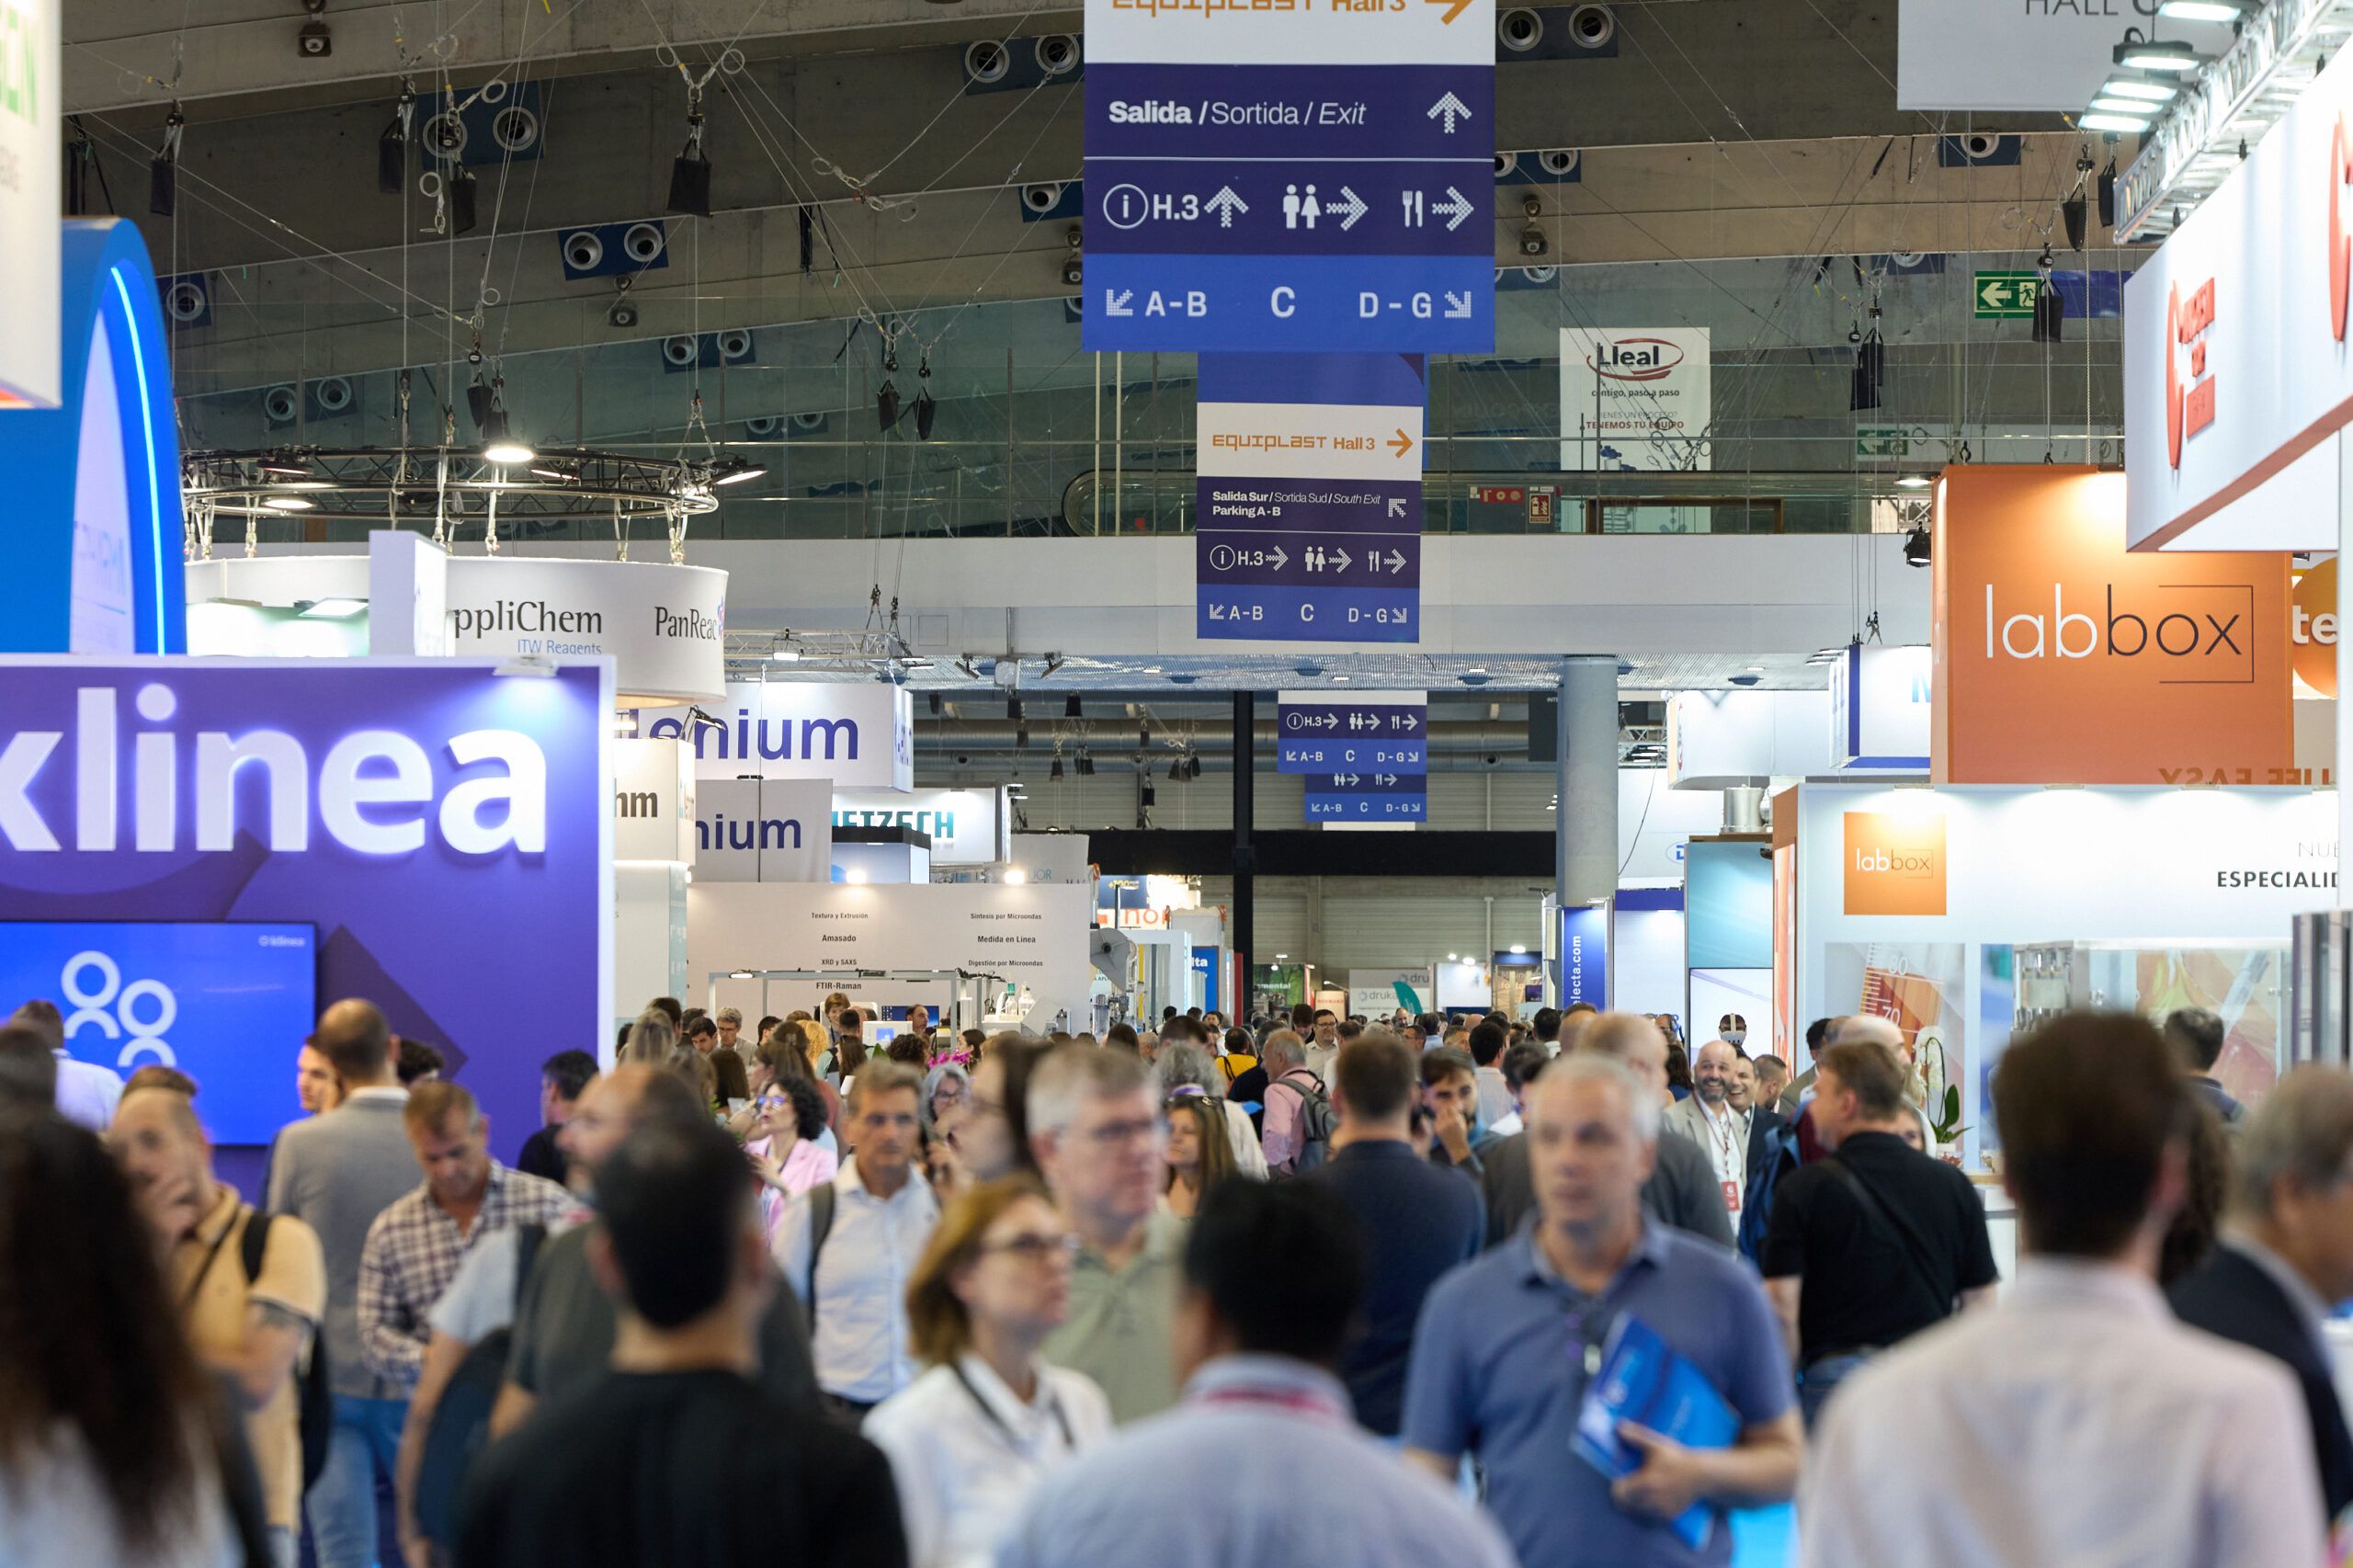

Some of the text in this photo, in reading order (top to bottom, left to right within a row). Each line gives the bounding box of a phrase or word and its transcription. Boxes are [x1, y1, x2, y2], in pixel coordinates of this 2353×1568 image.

[2025, 0, 2119, 16] HALL
[1108, 99, 1193, 124] Salida
[1211, 100, 1300, 125] Sortida
[1318, 101, 1367, 125] Exit
[1153, 193, 1199, 221] H.3
[1269, 286, 1296, 319] C
[1591, 388, 1626, 399] cntigo,
[1659, 389, 1680, 398] paso
[1593, 411, 1622, 420] ¿IENES
[1586, 421, 1685, 429] TENEMOS TU EQUIPO
[1333, 437, 1363, 450] Hall
[1366, 437, 1376, 450] 3
[1212, 491, 1248, 502] Salida
[1248, 492, 1268, 502] Sur
[1274, 492, 1307, 503] Sortida
[1308, 493, 1327, 504] Sud
[1333, 494, 1362, 505] South
[1363, 494, 1381, 505] Exit
[1212, 506, 1256, 517] Parking
[1237, 551, 1264, 566] H.3
[453, 599, 602, 640] ppliChem
[1300, 604, 1314, 622] C
[654, 606, 717, 641] PanReac
[1985, 583, 2243, 659] labbox
[517, 639, 602, 655] ITW Reagents
[1304, 716, 1322, 727] H.3
[1345, 750, 1356, 762] C
[1359, 802, 1369, 812] C
[831, 811, 954, 838] ETZSCH
[1856, 847, 1931, 872] labbox
[822, 934, 857, 942] Amasado
[977, 935, 1004, 943] Medida
[815, 982, 862, 990] FTIR-Raman
